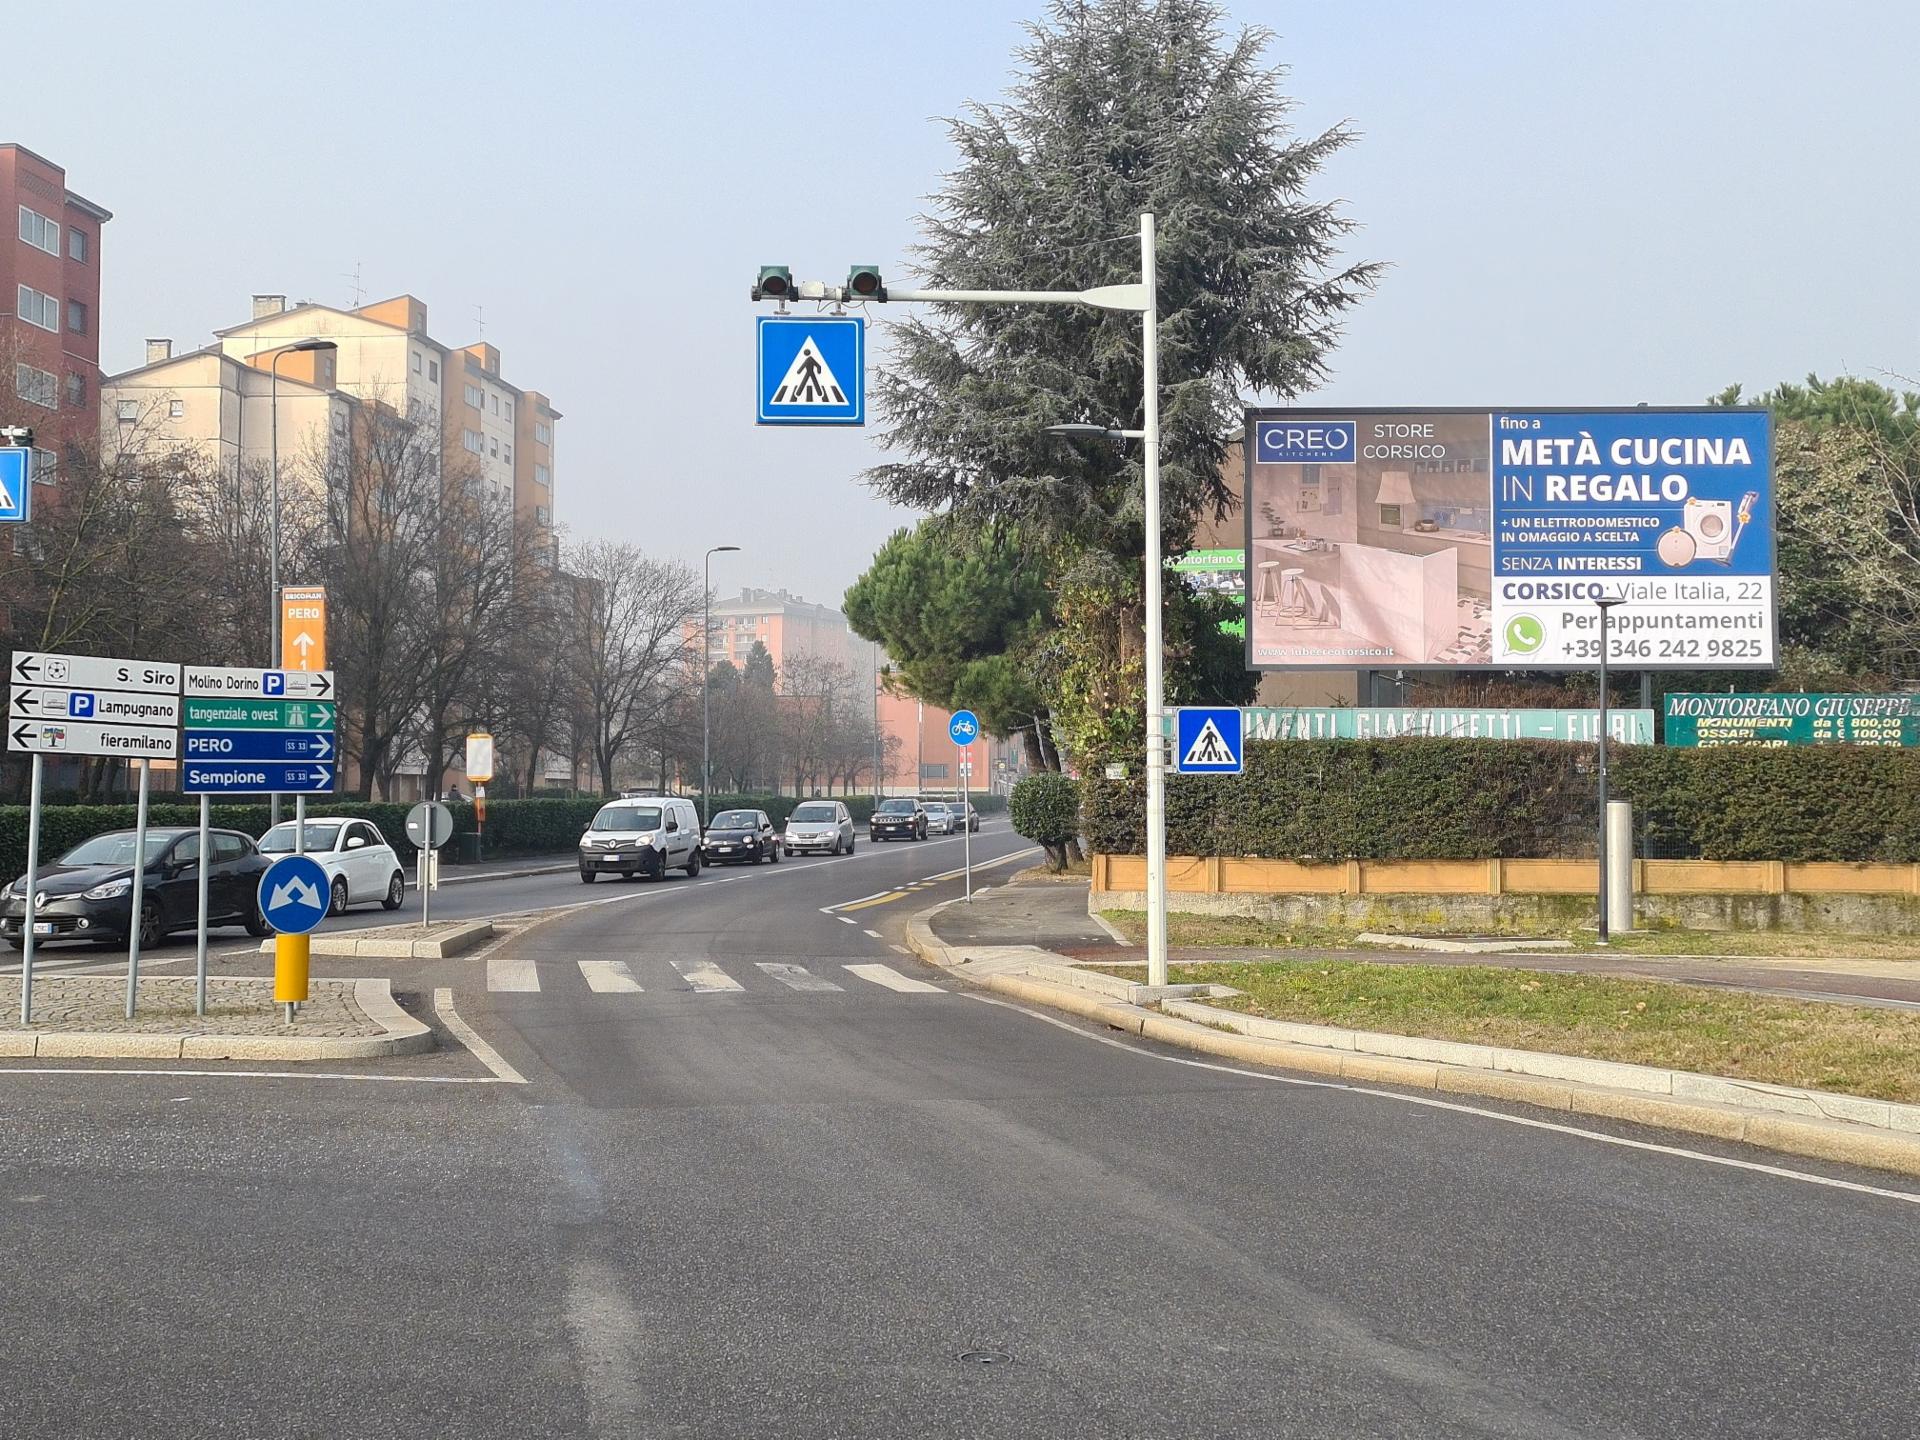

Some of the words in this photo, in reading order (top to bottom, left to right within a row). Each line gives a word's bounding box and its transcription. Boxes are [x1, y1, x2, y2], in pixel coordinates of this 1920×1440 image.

[1374, 424, 1434, 438] STORE
[1500, 416, 1528, 430] fino
[1532, 419, 1541, 430] a
[1265, 428, 1348, 450] CREO
[1363, 445, 1446, 459] CORSICO
[1502, 431, 1602, 466] METÀ
[1610, 438, 1752, 466] CUCINA
[1503, 475, 1533, 502] IN
[1546, 474, 1689, 502] REGALO
[1512, 518, 1530, 528] UN
[1534, 518, 1660, 528] ELETTRODOMESTICO
[1501, 532, 1515, 542] IN
[1518, 532, 1580, 542] OMAGGIO
[1583, 532, 1592, 542] A
[1594, 532, 1640, 542] SCELTA
[1502, 557, 1553, 570] SENZA
[1557, 557, 1642, 570] INTERESSI
[1616, 582, 1667, 600] Viale
[1674, 582, 1730, 602] Italia,
[1738, 582, 1763, 600] 22
[288, 608, 320, 619] PERO
[1562, 612, 1598, 629] Per
[1606, 612, 1763, 634] appuntamenti
[1562, 639, 1602, 658] +39
[1610, 639, 1651, 658] 346
[1658, 639, 1700, 658] 242
[1707, 639, 1763, 658] 9825
[117, 668, 132, 682] S.
[142, 670, 175, 686] Siro
[189, 675, 222, 689] Molino
[227, 676, 259, 690] Dorino
[99, 699, 174, 718] Lampugnano
[190, 706, 248, 722] tangenziale
[252, 708, 278, 721] ovest
[1668, 698, 1810, 716] MONTORFANO
[1815, 698, 1912, 716] GIUSEPPE
[1696, 718, 1793, 727] MONUMENTI
[1814, 718, 1832, 727] da
[1836, 718, 1844, 727] €
[1851, 718, 1901, 729] 800,00
[100, 733, 172, 750] fieramilano
[1697, 729, 1754, 738] OSSARI
[1814, 729, 1832, 738] da
[1837, 729, 1845, 738] €
[1852, 729, 1902, 740] 100,00
[188, 738, 233, 752] PERO
[287, 742, 295, 750] SS
[298, 742, 306, 750] 33
[189, 770, 266, 786] Sempione
[287, 772, 295, 780] SS
[298, 772, 306, 780] 33
